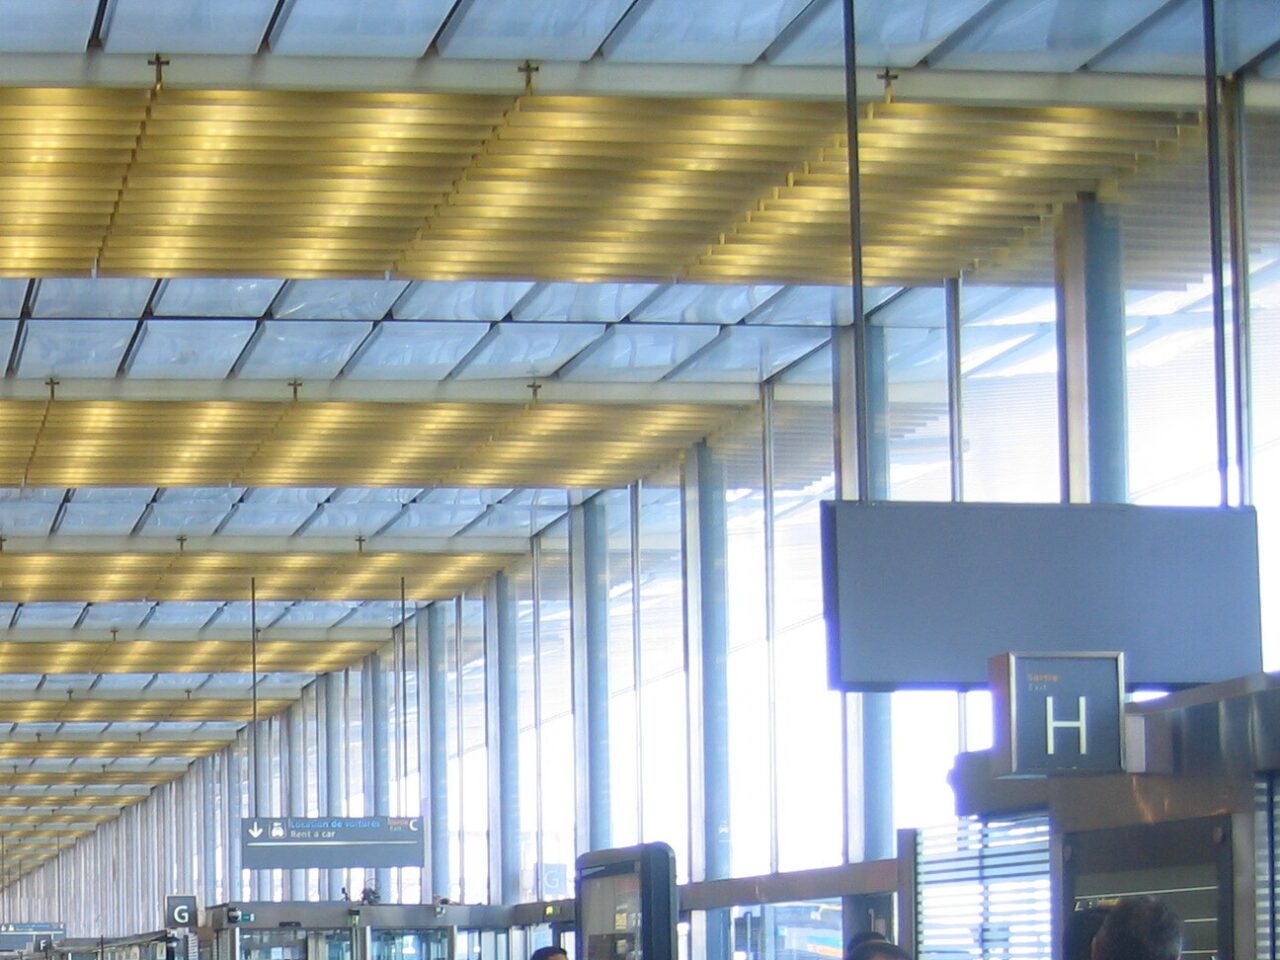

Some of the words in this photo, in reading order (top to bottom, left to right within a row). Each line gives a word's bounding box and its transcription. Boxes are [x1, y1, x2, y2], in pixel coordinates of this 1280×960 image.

[1046, 696, 1087, 755] H
[330, 820, 343, 828] de
[409, 818, 419, 832] C
[290, 830, 312, 838] Rent
[173, 905, 189, 923] G
